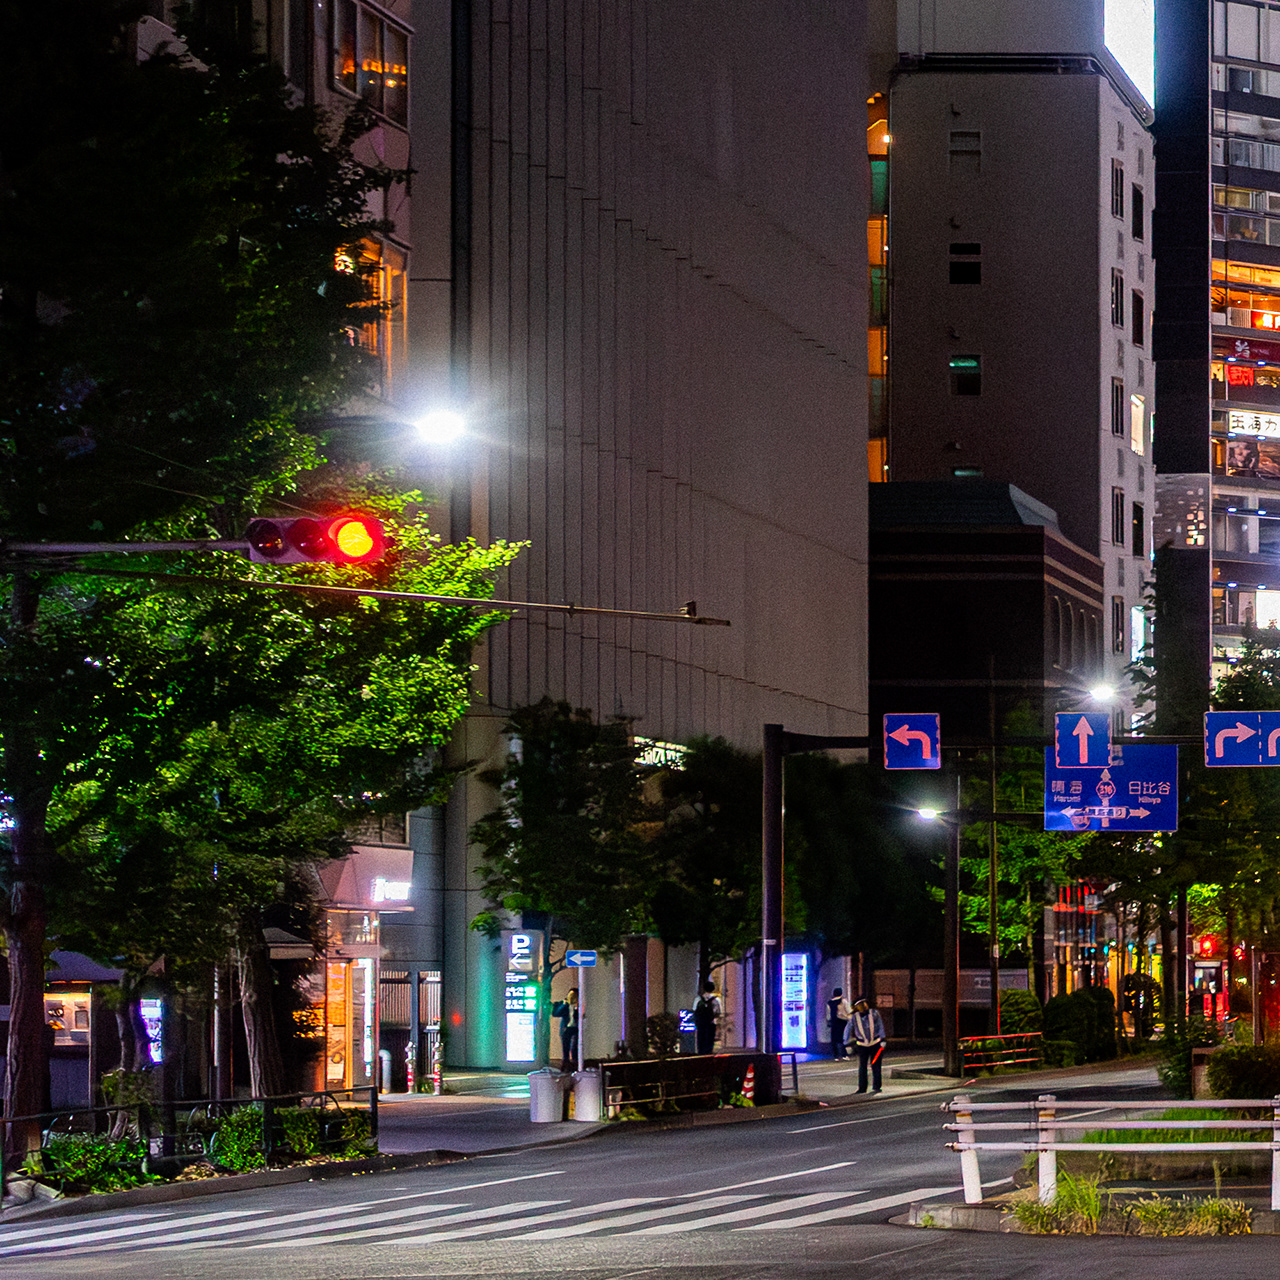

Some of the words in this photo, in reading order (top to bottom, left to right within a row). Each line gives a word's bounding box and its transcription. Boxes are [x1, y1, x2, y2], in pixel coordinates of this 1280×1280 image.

[1129, 781, 1171, 795] 日比谷
[511, 934, 531, 954] P
